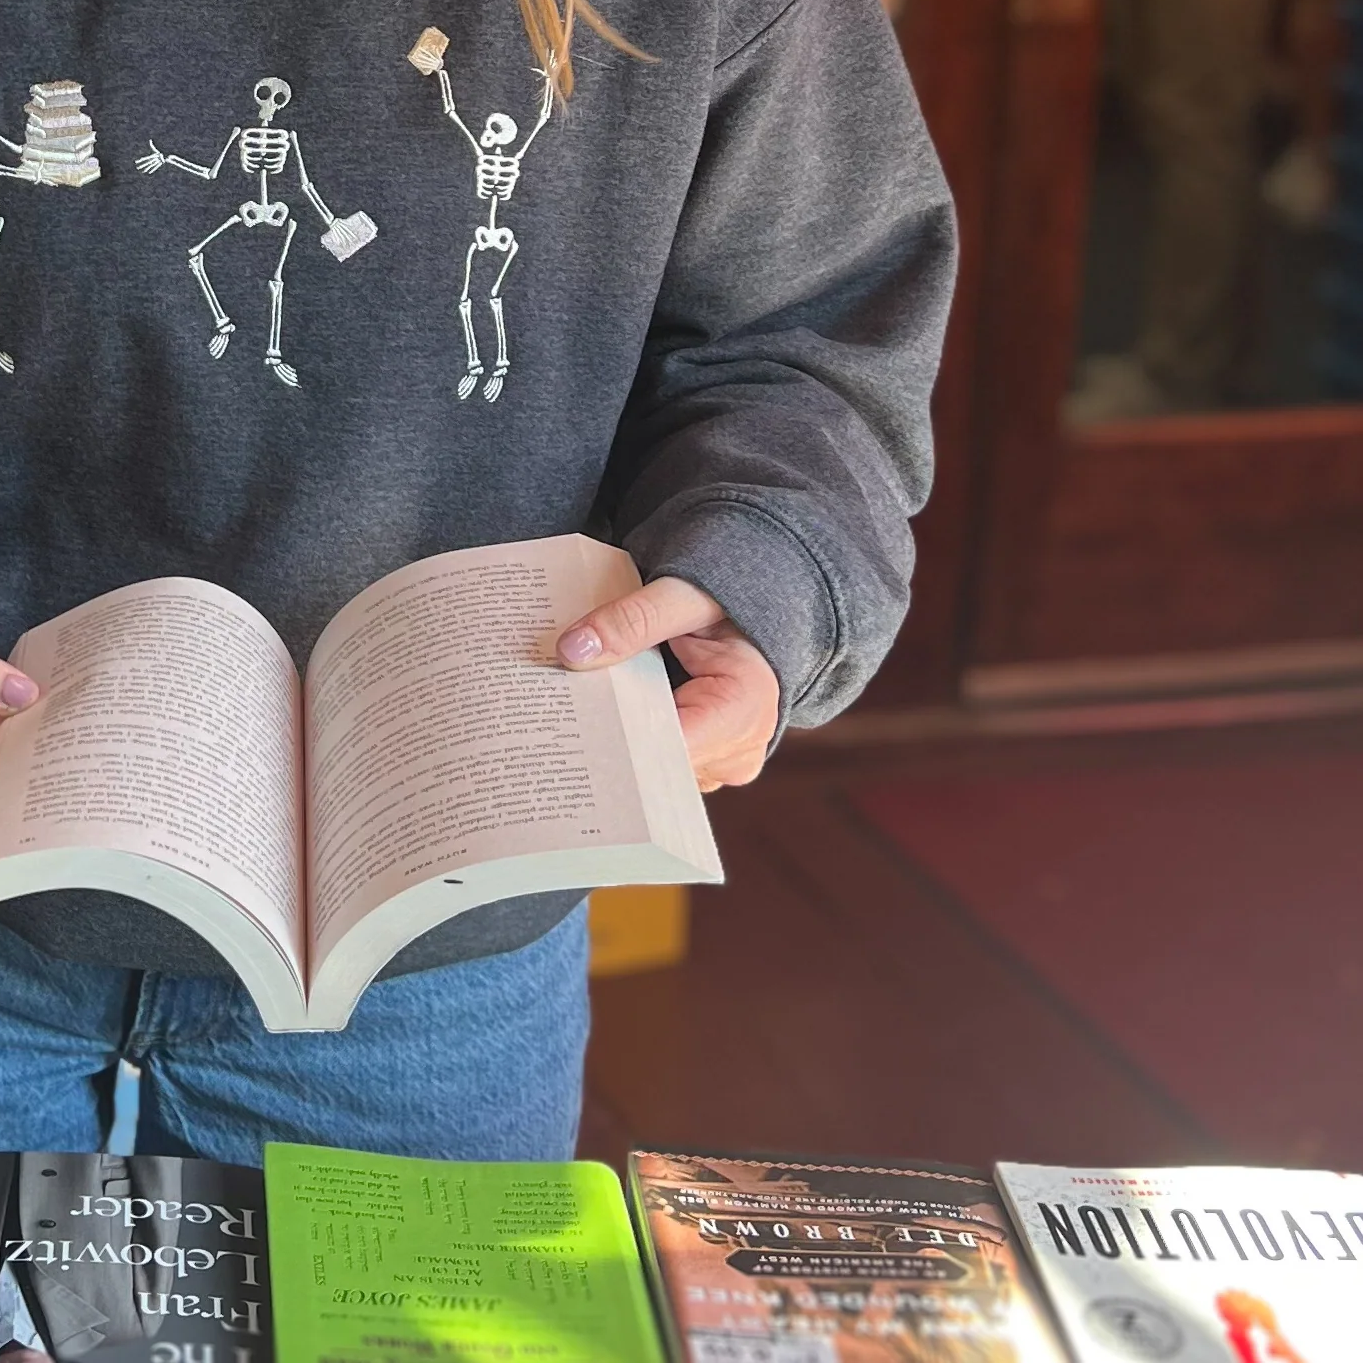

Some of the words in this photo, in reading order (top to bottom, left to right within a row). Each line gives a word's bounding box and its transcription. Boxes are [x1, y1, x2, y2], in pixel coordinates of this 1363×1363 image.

[504, 761, 545, 770] thinking
[503, 772, 528, 780] drive
[543, 767, 587, 775] intention
[536, 778, 555, 786] had
[558, 774, 589, 782] phone
[474, 783, 505, 795] asking
[533, 784, 591, 795] increasingly
[492, 790, 530, 800] anxious
[419, 803, 436, 812] was
[446, 797, 489, 811] messages
[491, 799, 531, 809] message
[422, 810, 443, 820] from
[464, 806, 487, 816] from
[459, 815, 495, 827] nodded
[504, 816, 534, 826] phone
[429, 836, 450, 847] Cole
[437, 849, 467, 862] RUTH
[404, 861, 433, 876] WARE
[1070, 1177, 1138, 1185] MASSACRE
[679, 1188, 728, 1197] THUNDER
[724, 1199, 789, 1210] HAMPTON
[818, 1204, 893, 1213] FOREWORD
[929, 1202, 971, 1211] AUTHOR
[898, 1207, 929, 1215] NEW
[948, 1211, 983, 1221] WITH
[70, 1194, 257, 1240] Reader
[698, 1217, 856, 1241] BROWN
[894, 1226, 978, 1247] DEE
[450, 1242, 495, 1252] MUSIC
[499, 1244, 575, 1253] CHAMBER
[5, 1239, 261, 1286] Lebowitz
[413, 1256, 481, 1266] HOMAGE
[758, 1255, 803, 1264] WEST
[810, 1257, 895, 1267] AMERICAN
[902, 1259, 935, 1268] THE
[455, 1268, 482, 1276] ACT
[752, 1264, 774, 1272] OF
[780, 1266, 851, 1275] HISTORY
[393, 1274, 415, 1283] AN
[419, 1276, 433, 1284] IS
[437, 1277, 470, 1286] KISS
[474, 1279, 484, 1287] A
[332, 1288, 411, 1308] JOYCE
[686, 1286, 783, 1308] KNEE
[416, 1294, 503, 1314] JAMES
[794, 1293, 980, 1312] WOUNDED
[137, 1291, 263, 1336] Fran
